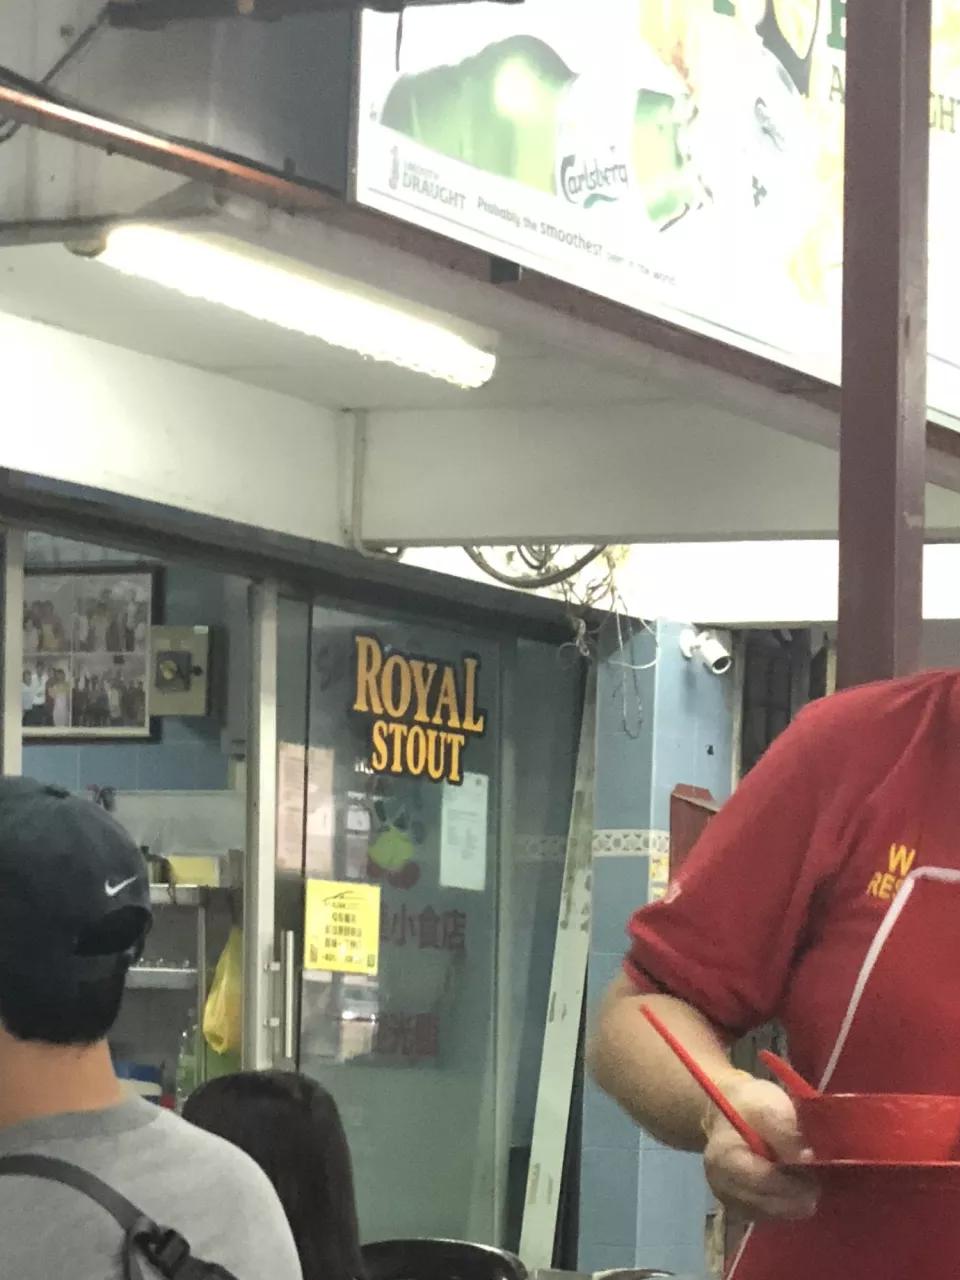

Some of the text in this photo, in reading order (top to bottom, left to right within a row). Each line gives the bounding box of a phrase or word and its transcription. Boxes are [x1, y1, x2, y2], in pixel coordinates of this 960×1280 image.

[402, 171, 467, 211] DRAUGHT
[477, 195, 521, 228] Probably
[353, 635, 484, 733] ROYAL
[372, 720, 465, 781] STOUT
[889, 842, 916, 877] W
